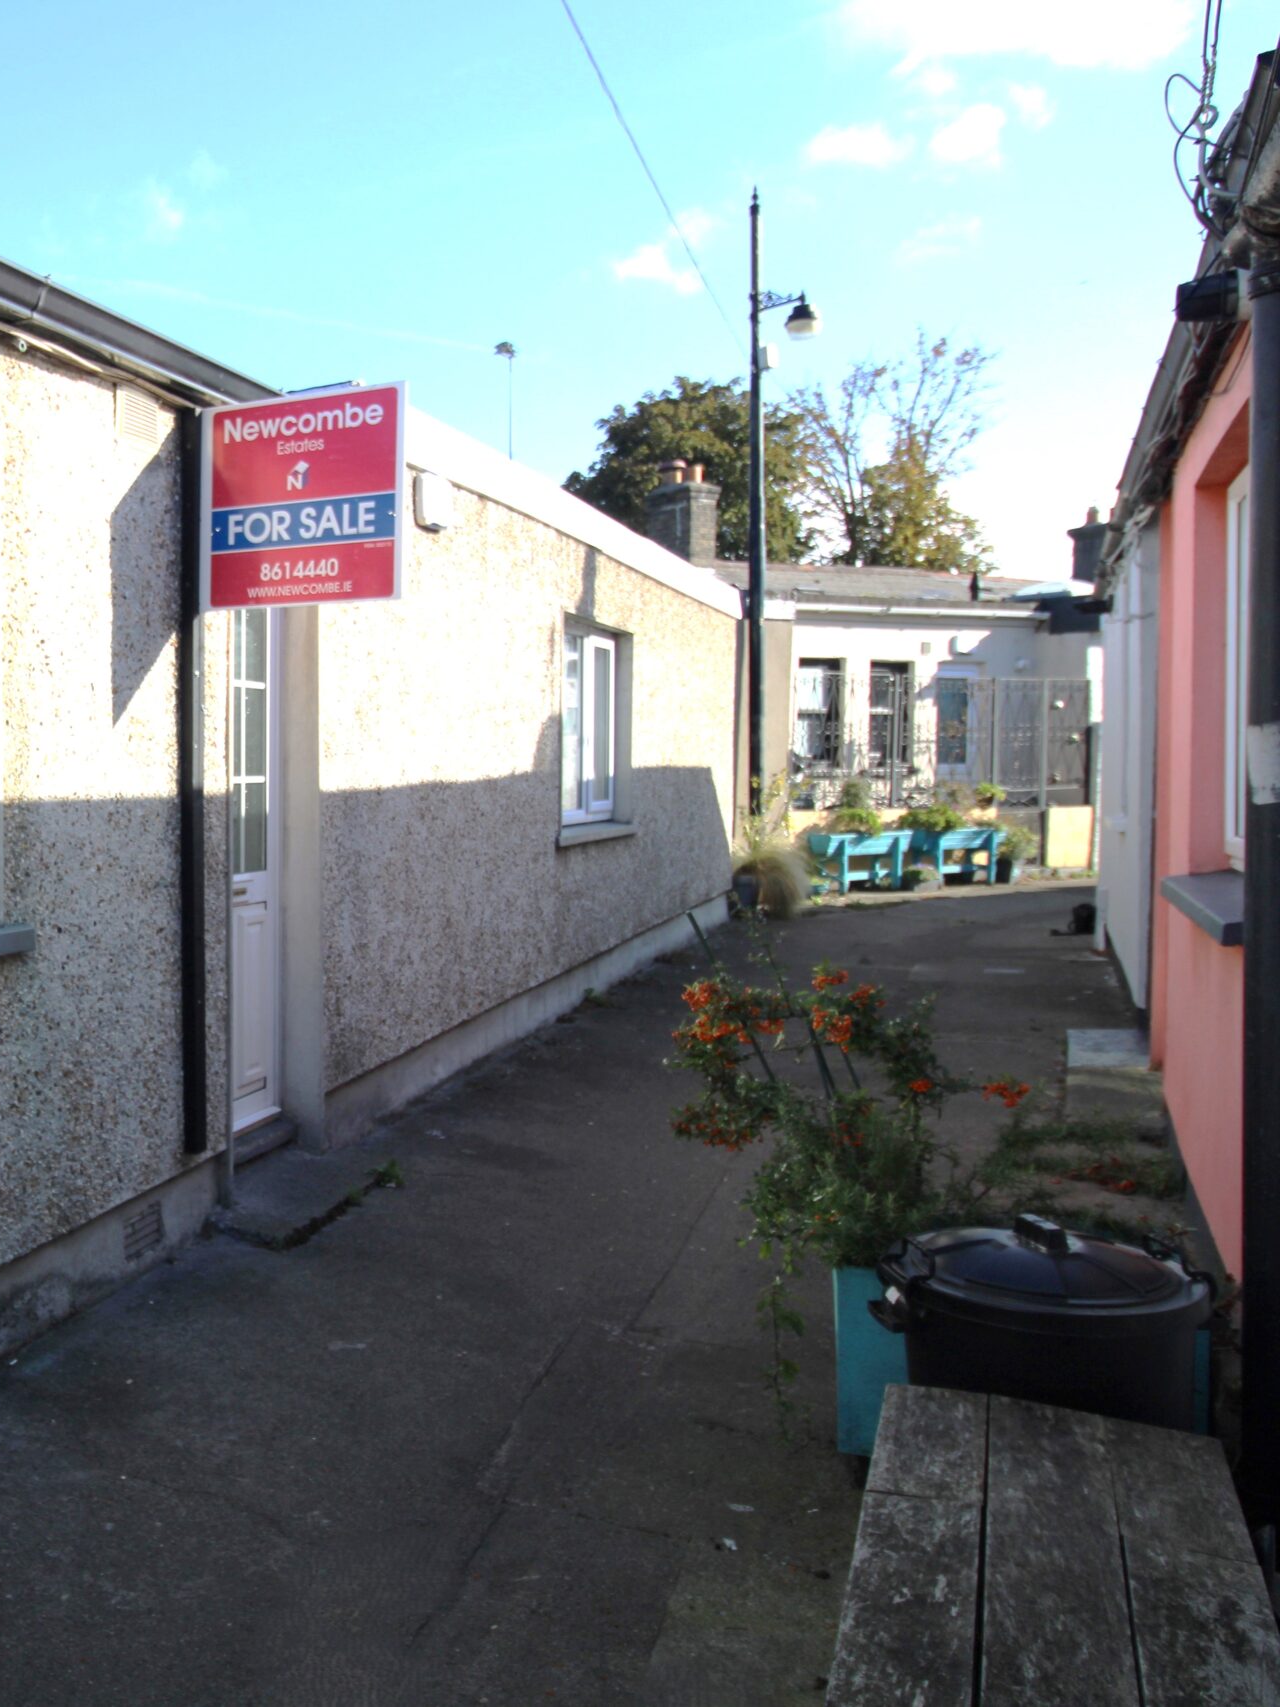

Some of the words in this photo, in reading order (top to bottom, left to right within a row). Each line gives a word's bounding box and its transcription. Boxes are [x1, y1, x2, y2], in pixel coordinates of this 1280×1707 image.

[223, 403, 384, 444] Newcombe
[276, 438, 325, 456] Estates
[286, 474, 303, 491] N
[227, 511, 291, 546] FOR
[299, 501, 376, 539] SALE
[259, 558, 339, 582] 8614440
[247, 581, 353, 598] WWW.NEWCOMBE.IE
